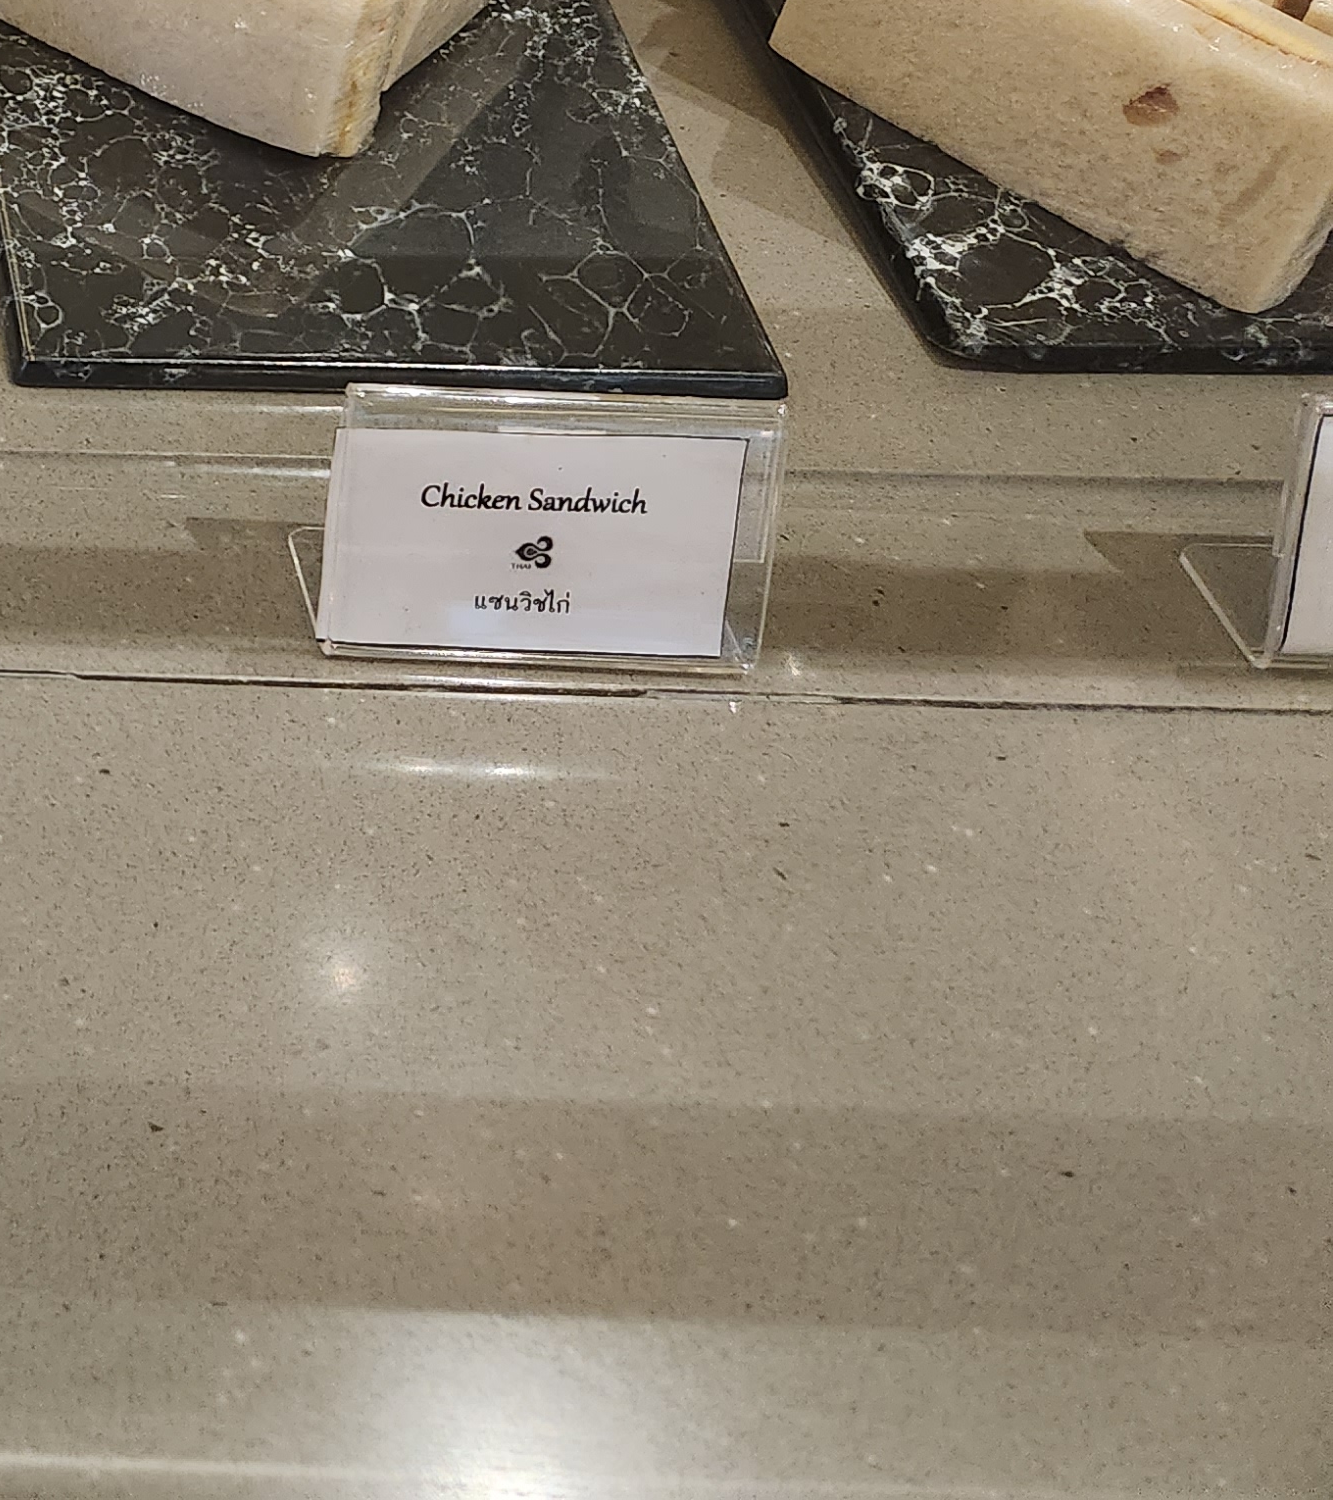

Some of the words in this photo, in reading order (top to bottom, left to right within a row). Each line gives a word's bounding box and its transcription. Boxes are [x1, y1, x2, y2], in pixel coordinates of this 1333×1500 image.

[421, 482, 522, 510] Chicken
[527, 487, 648, 514] Sandwich
[474, 588, 571, 614] แซนวิชไก่
